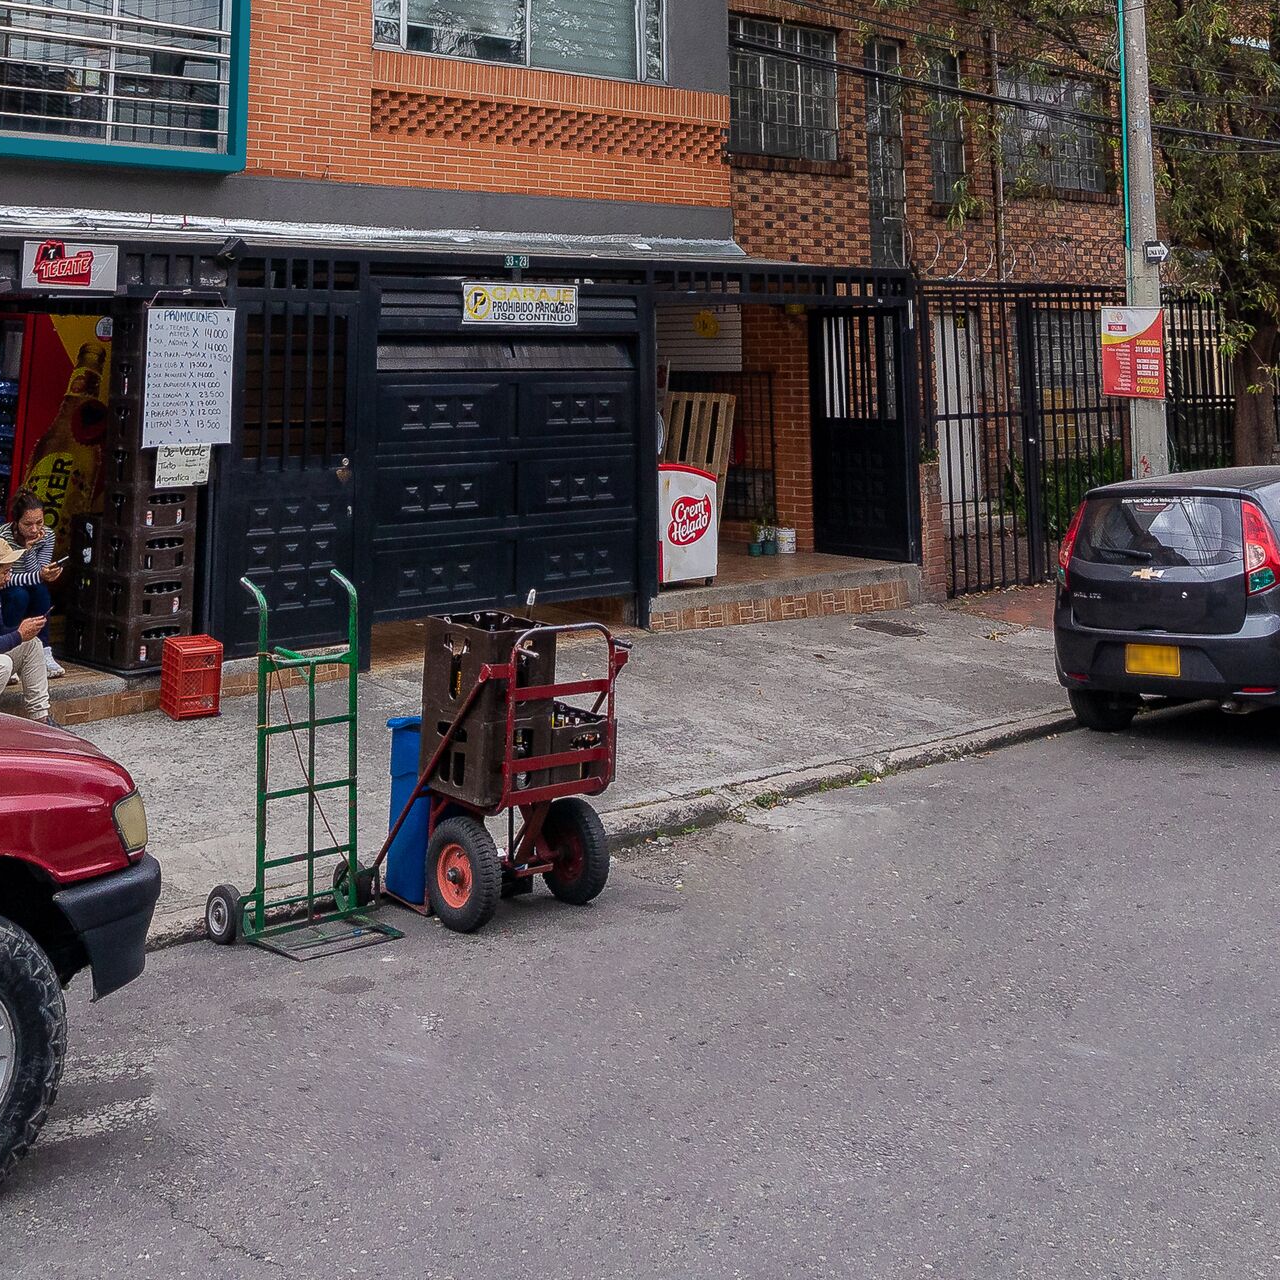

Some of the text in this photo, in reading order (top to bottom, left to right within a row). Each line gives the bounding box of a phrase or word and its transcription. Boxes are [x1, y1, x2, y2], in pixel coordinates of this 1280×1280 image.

[40, 257, 91, 278] TECATE
[505, 256, 514, 266] 33
[519, 256, 527, 266] 23
[492, 287, 574, 302] GARAJE
[492, 301, 534, 313] PROHIBIDO
[164, 310, 218, 325] PROMOCIONES
[518, 313, 572, 322] CONTINUO
[179, 444, 206, 456] Vende
[43, 457, 73, 529] OKER
[675, 501, 705, 522] Crem
[672, 512, 708, 542] Helado
